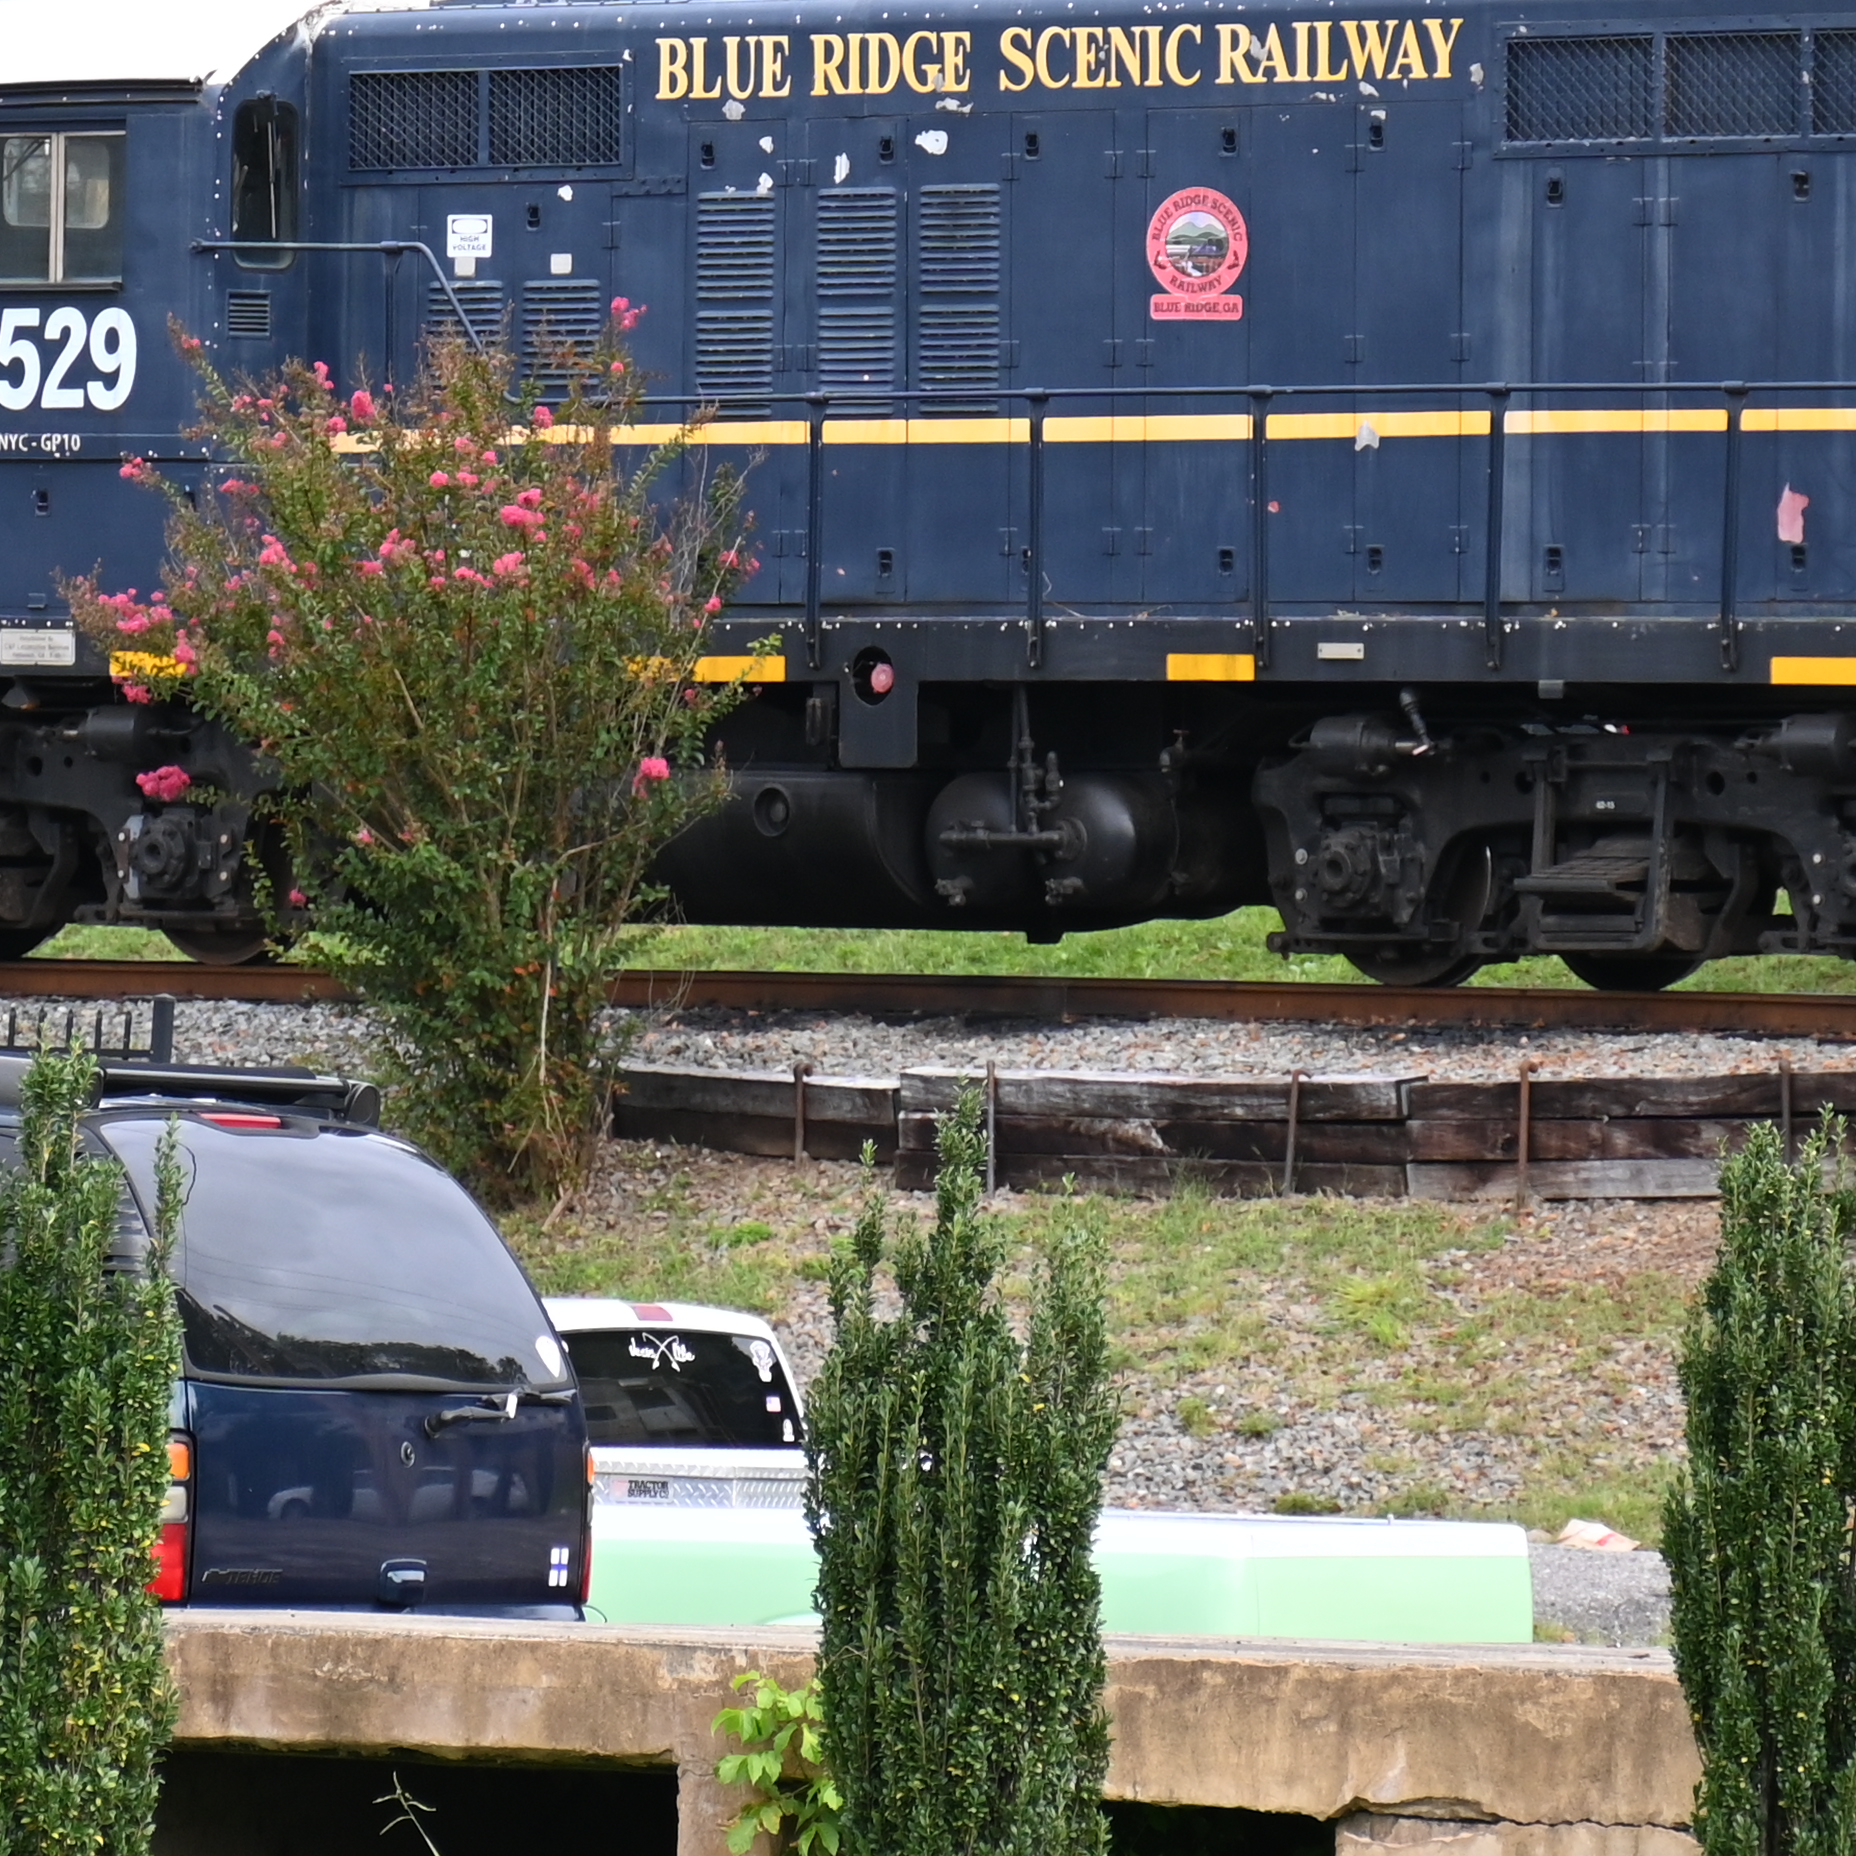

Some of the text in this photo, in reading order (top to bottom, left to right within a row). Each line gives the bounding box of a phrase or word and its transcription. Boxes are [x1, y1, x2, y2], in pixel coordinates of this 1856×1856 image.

[655, 17, 1464, 100] BLUE RIDGE SCENIC RAILWAY
[1152, 194, 1243, 242] BLUE RIDGE SCENIC
[460, 235, 480, 243] HIGH
[1169, 275, 1223, 293] RAILWAY
[1154, 302, 1181, 313] BLUE
[628, 1480, 669, 1490] TRACTOR
[627, 1489, 659, 1498] SUPPLY
